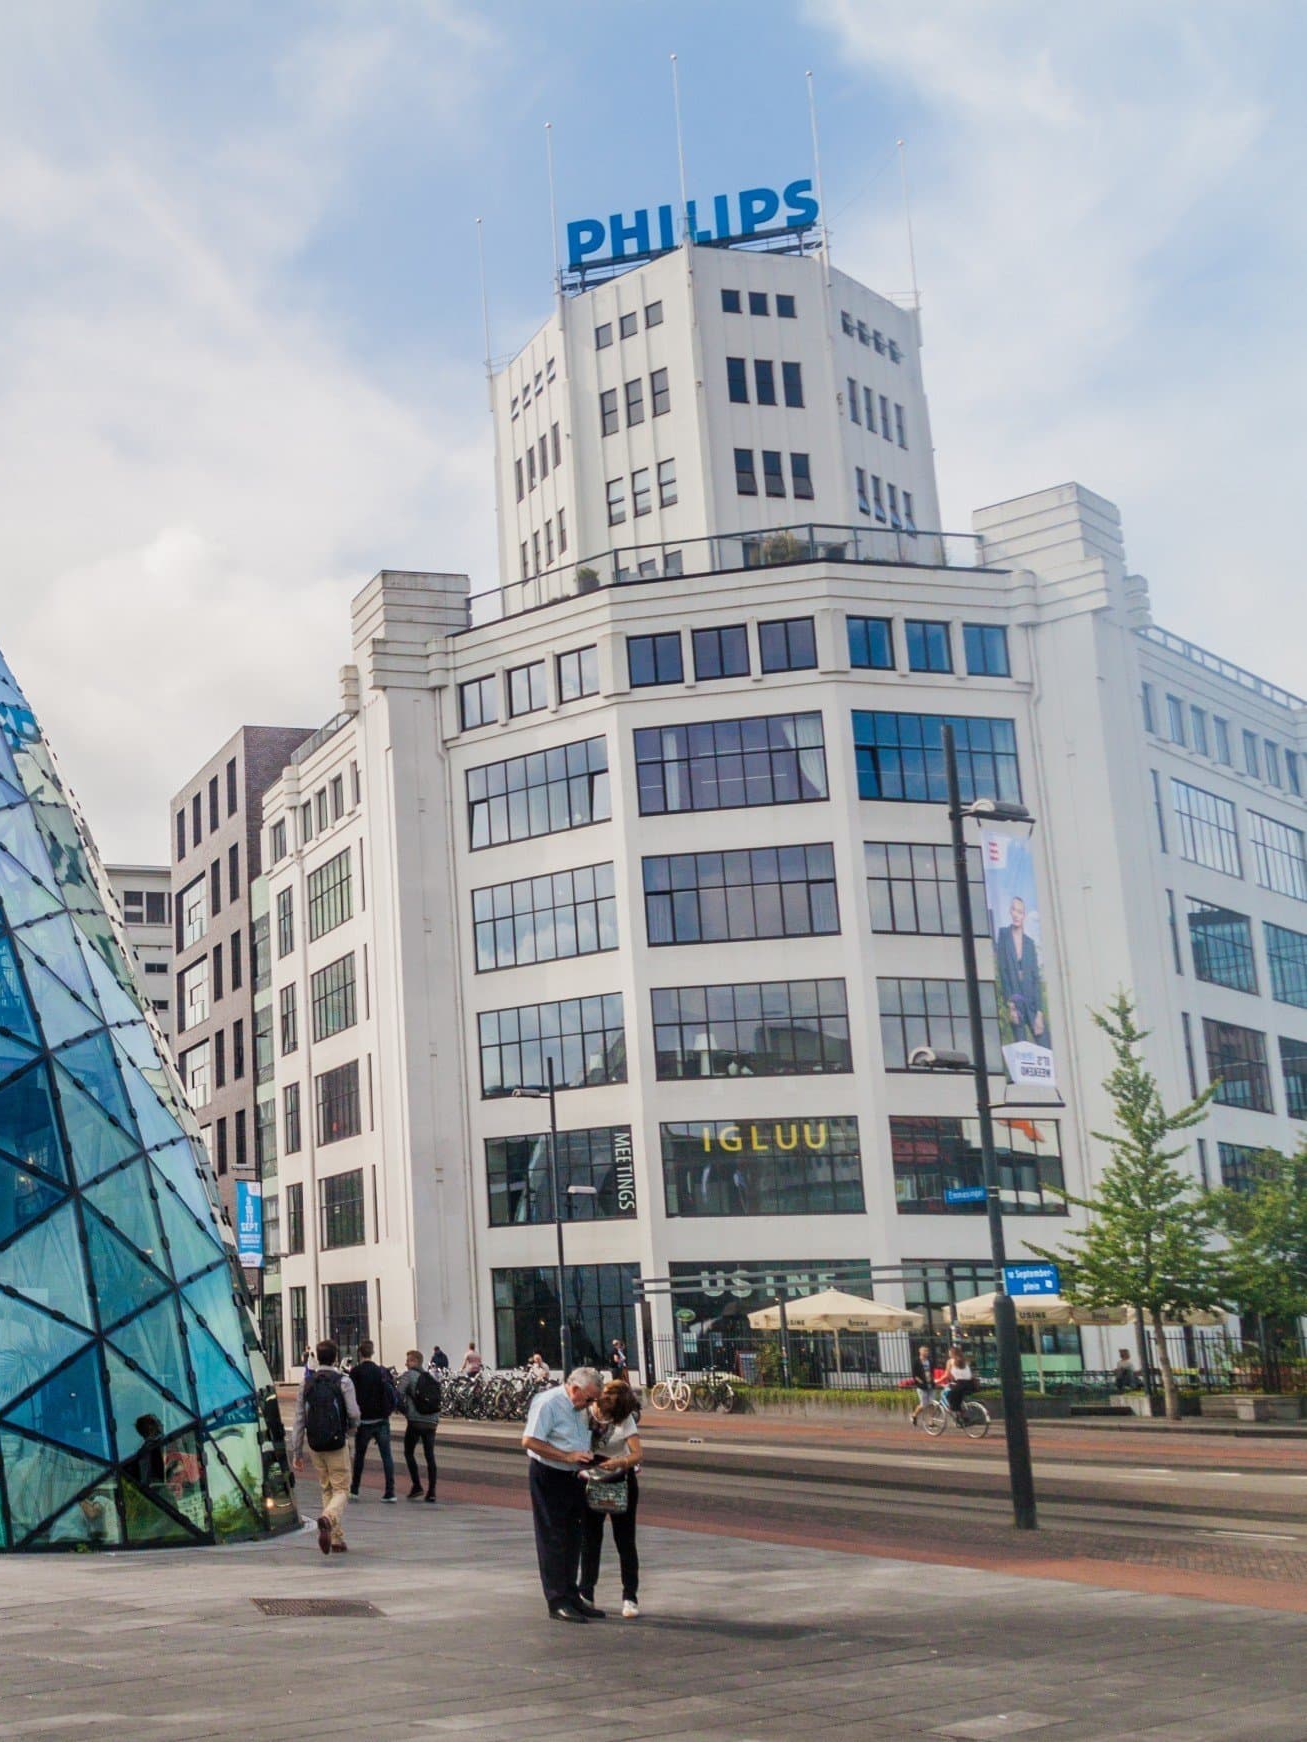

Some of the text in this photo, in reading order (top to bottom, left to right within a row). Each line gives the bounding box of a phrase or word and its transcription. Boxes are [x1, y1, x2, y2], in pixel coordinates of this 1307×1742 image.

[567, 179, 819, 267] PHILIPS
[614, 1133, 635, 1211] MEETINGS
[701, 1122, 827, 1152] IGLUU
